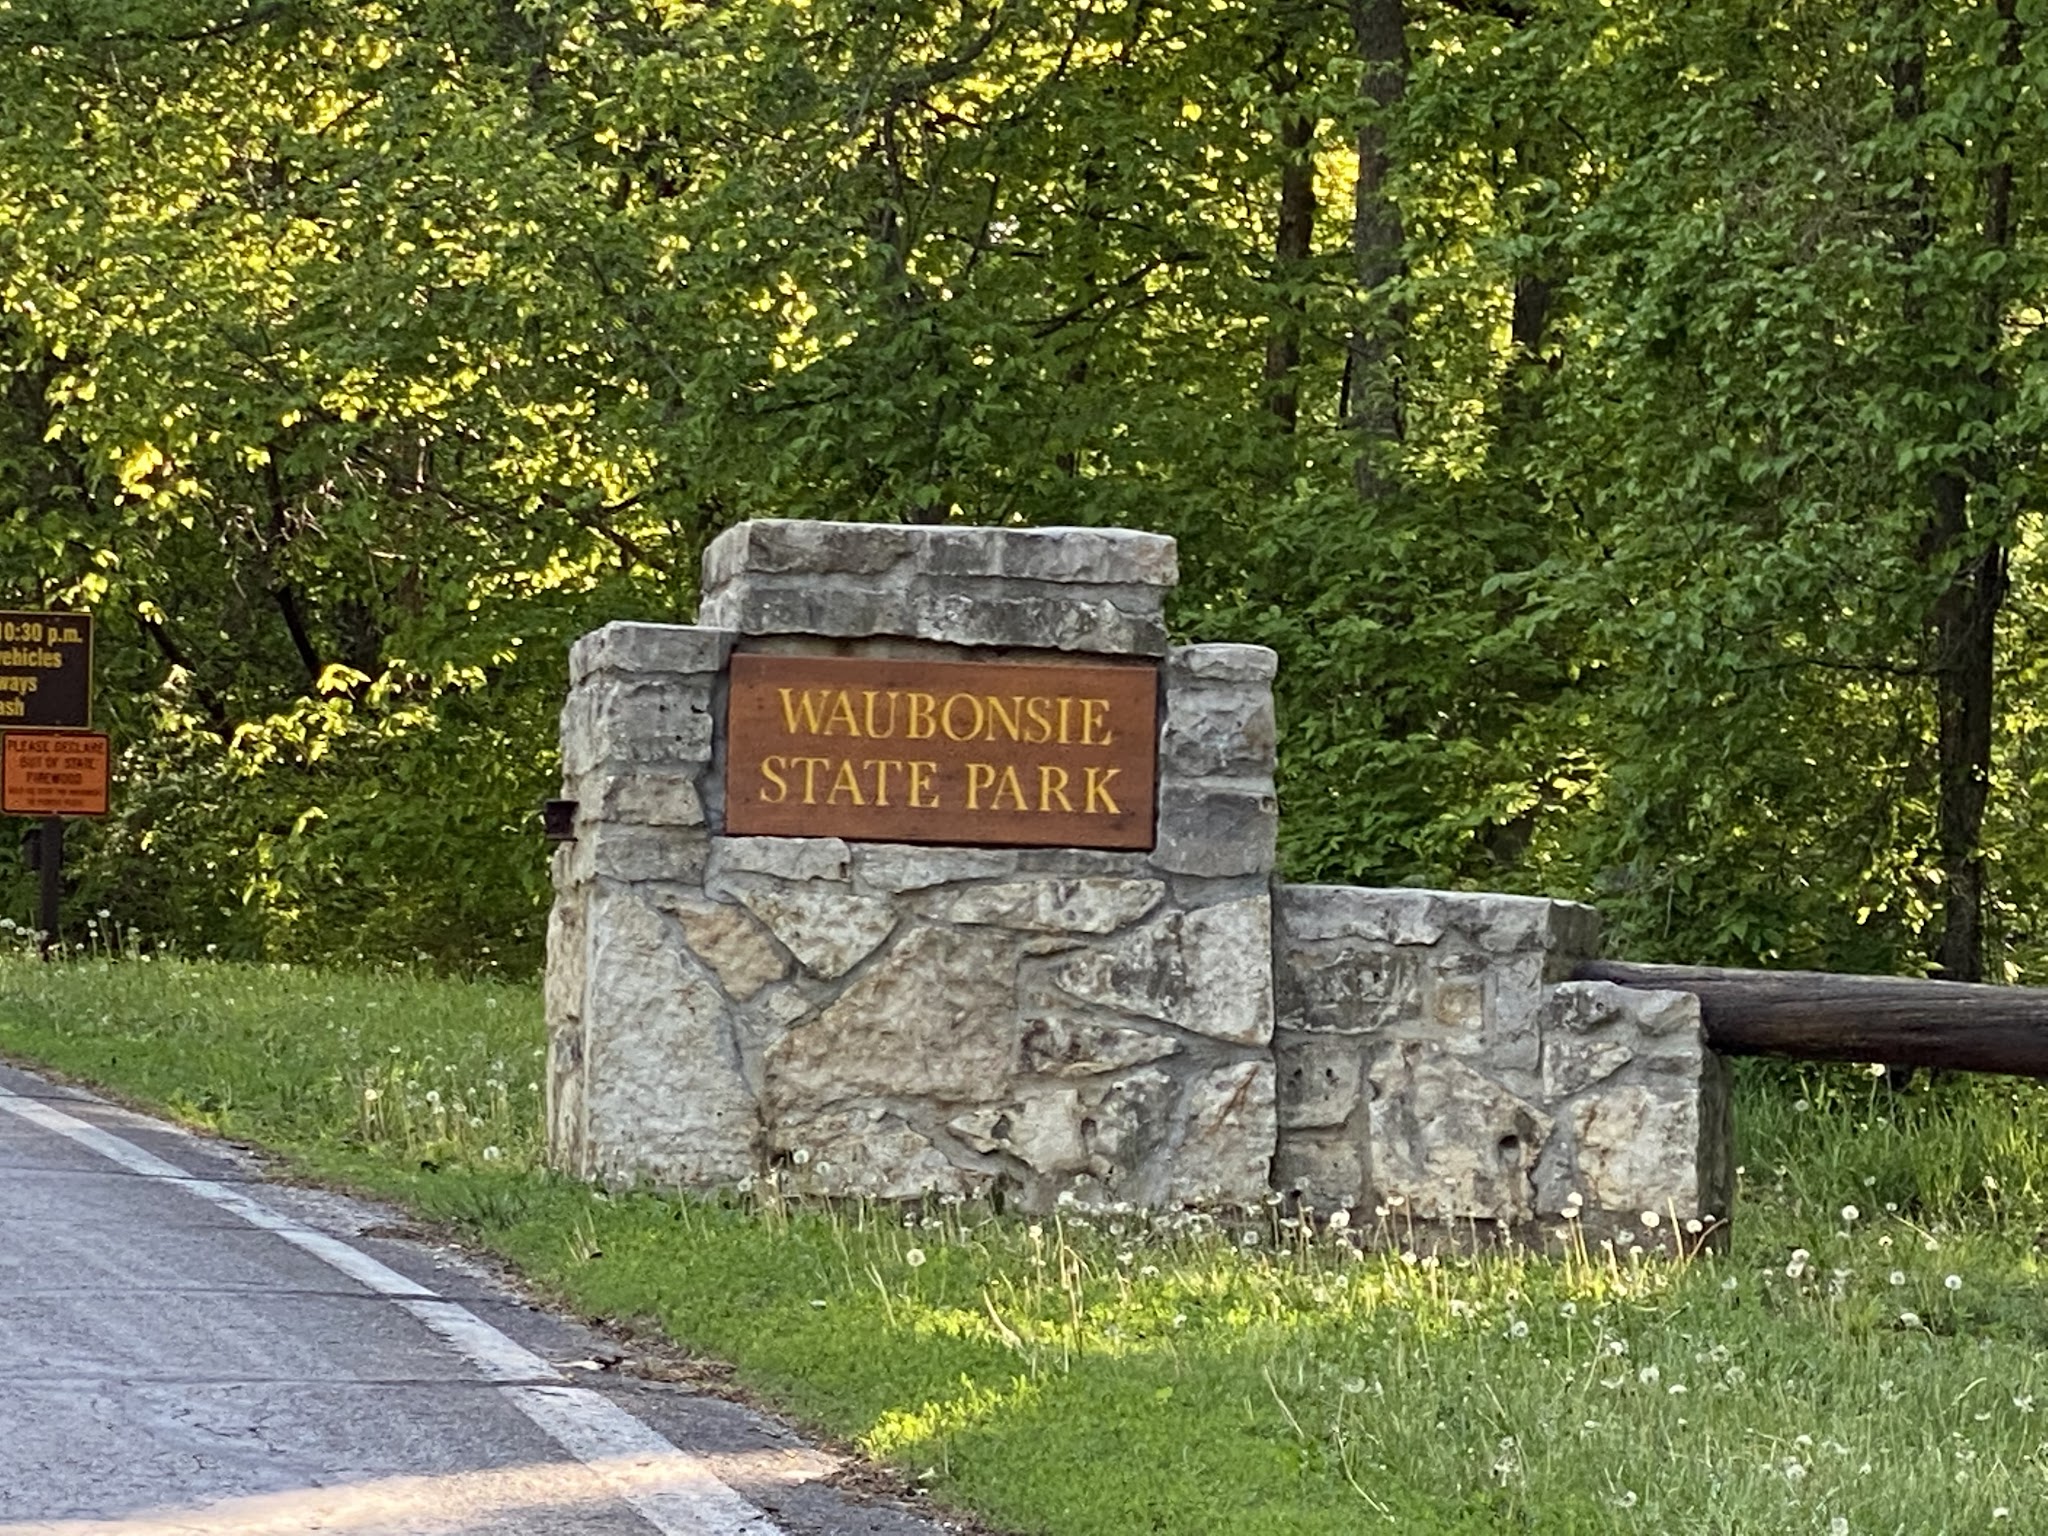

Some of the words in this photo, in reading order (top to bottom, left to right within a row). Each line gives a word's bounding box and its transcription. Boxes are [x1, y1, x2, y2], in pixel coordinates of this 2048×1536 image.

[47, 626, 83, 647] p.m.
[778, 687, 1114, 747] WAUBONSIE
[8, 740, 50, 752] PLEASE
[760, 755, 940, 808] STATE
[966, 762, 1123, 815] PARK
